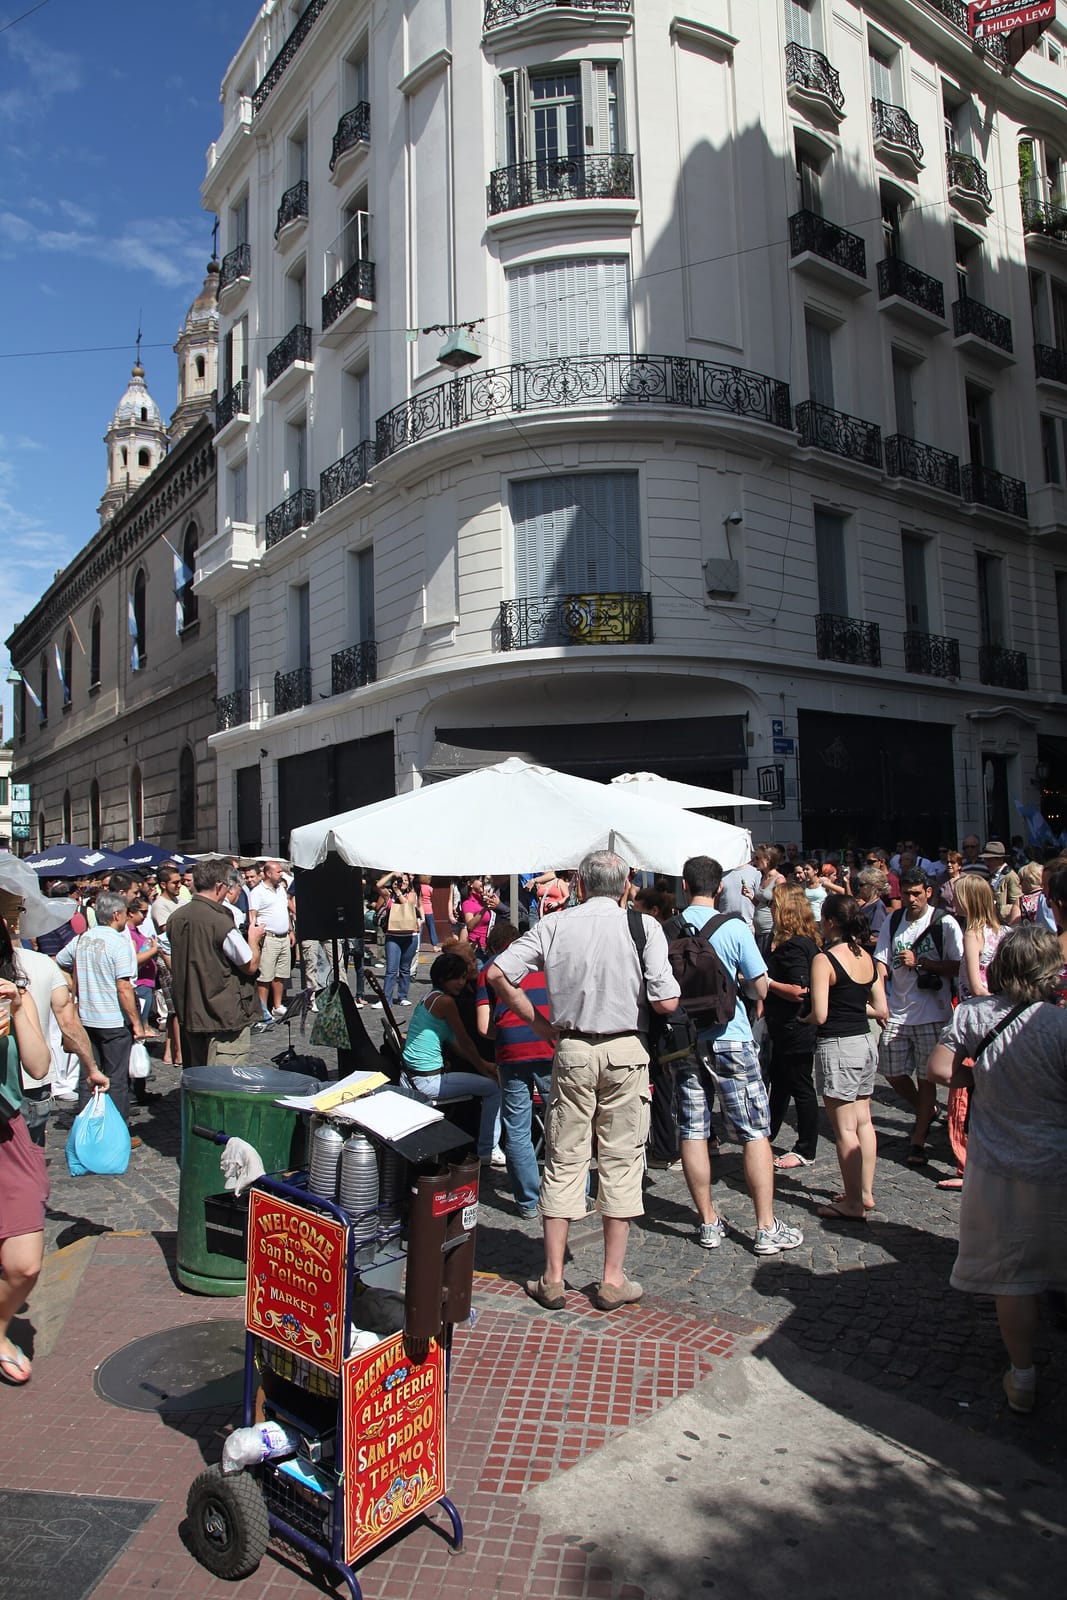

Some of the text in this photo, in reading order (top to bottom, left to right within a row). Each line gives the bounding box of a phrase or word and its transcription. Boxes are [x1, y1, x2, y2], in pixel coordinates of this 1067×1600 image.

[987, 6, 1051, 32] HILDA LEW
[258, 1213, 335, 1260] WELCOME
[260, 1238, 281, 1260] San
[269, 1260, 318, 1296] Telmo
[270, 1286, 317, 1318] MARKET
[361, 1368, 434, 1425] A LA FERIA
[388, 1408, 404, 1429] DE
[358, 1404, 433, 1472] SAN PEDRO
[369, 1440, 424, 1490] TELMO
